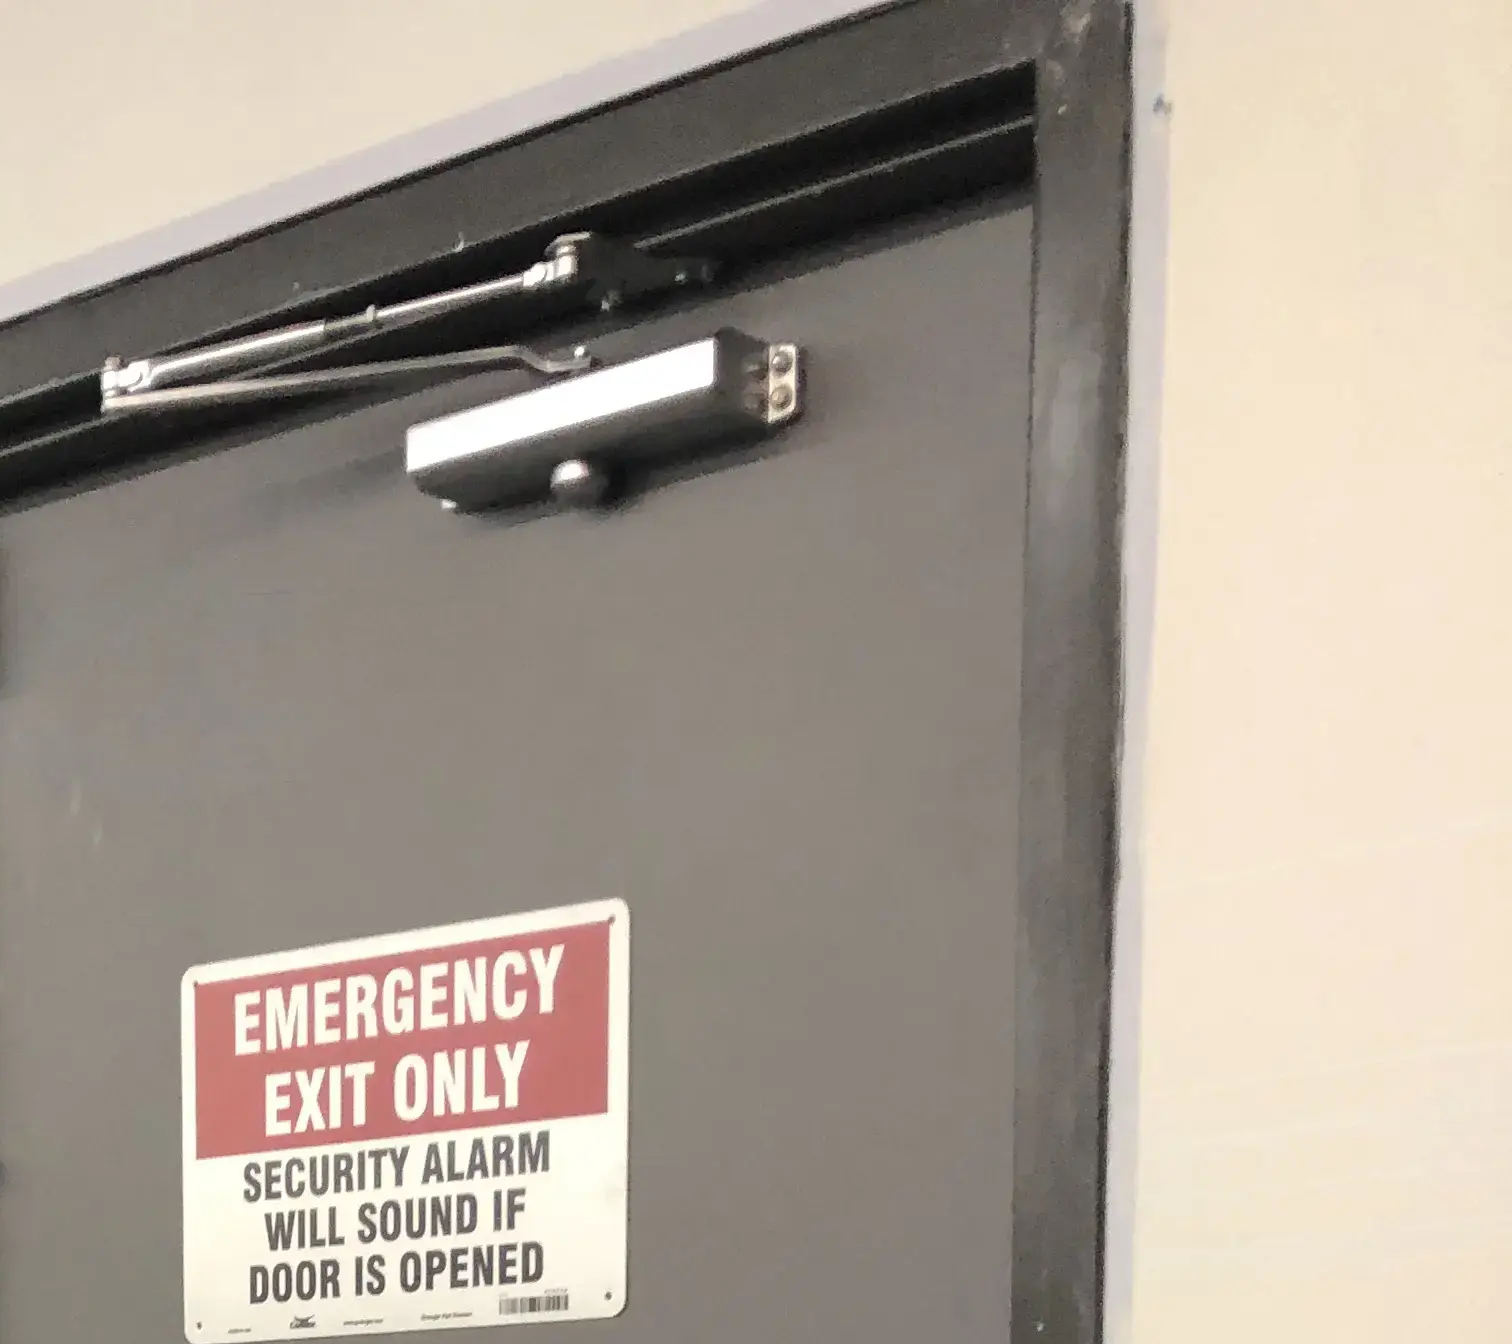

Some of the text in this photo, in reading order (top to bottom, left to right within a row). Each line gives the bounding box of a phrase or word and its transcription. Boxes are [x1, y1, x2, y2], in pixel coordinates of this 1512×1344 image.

[234, 944, 565, 1056] EMERGENCY
[265, 1039, 531, 1137] EXIT ONLY
[244, 1130, 550, 1203] SECURITY ALARM
[265, 1188, 526, 1251] WILL SOUND IF
[249, 1241, 544, 1305] DOOR IS OPENED
